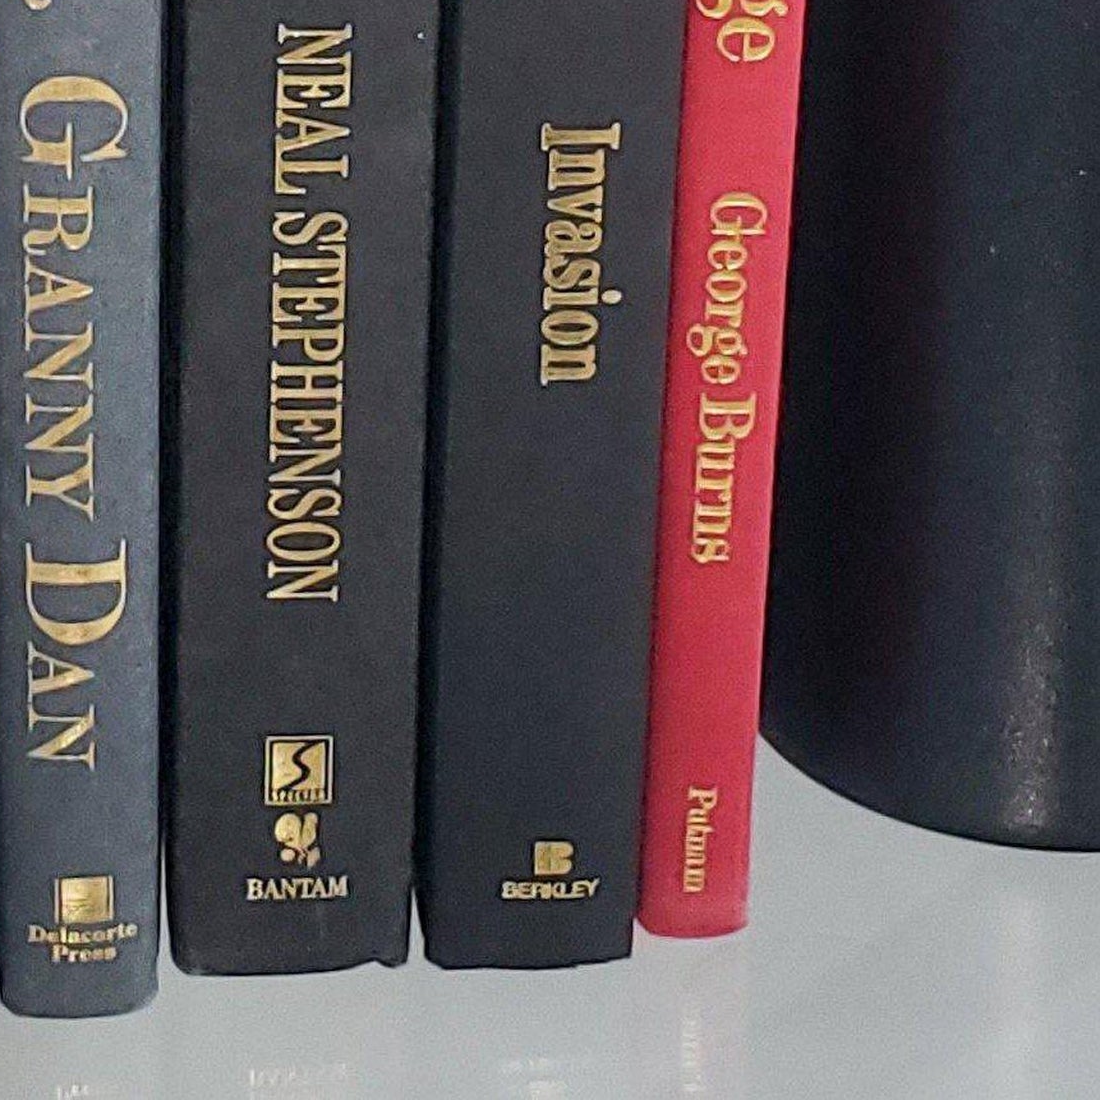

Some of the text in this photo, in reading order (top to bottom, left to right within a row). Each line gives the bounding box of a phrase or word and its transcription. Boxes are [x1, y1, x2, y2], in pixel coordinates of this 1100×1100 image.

[267, 24, 352, 602] NEAL STEPHENSON
[541, 123, 622, 385] Invasion
[20, 77, 127, 767] GRANNY DAN
[686, 192, 768, 565] George Burns
[27, 923, 138, 943] Delacorte
[52, 944, 117, 962] Press
[247, 876, 349, 900] BANTAM
[502, 878, 600, 899] BERKLEY
